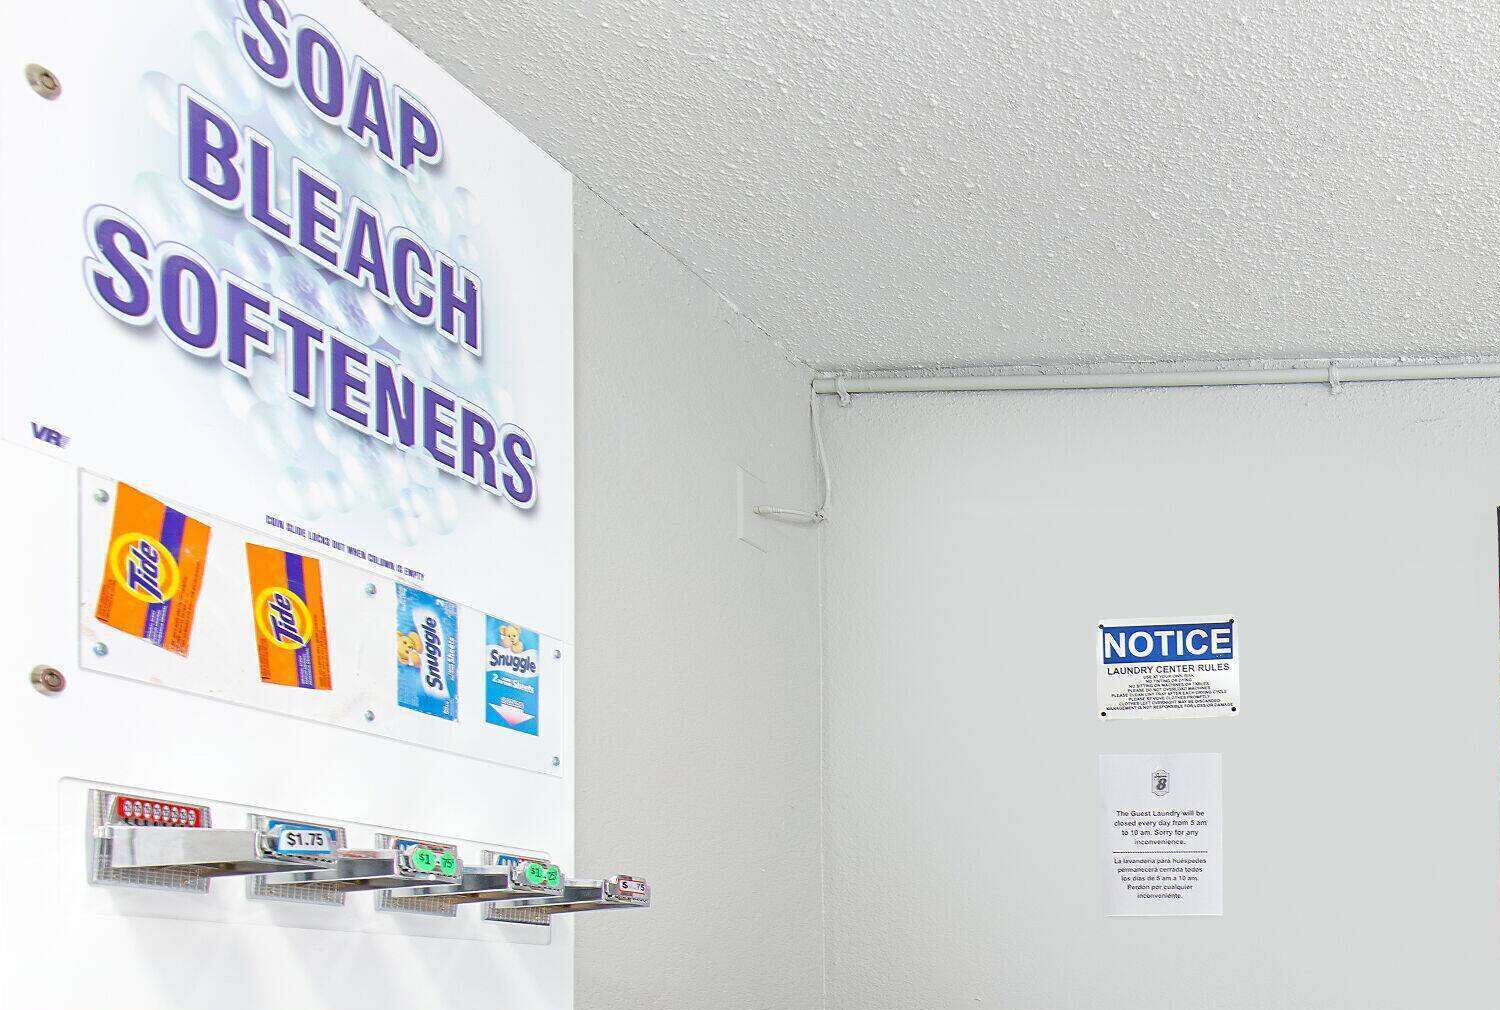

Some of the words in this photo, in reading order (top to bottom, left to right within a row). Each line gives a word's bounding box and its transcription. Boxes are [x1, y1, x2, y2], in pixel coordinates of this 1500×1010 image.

[242, 0, 440, 170] SOAP
[187, 95, 481, 351] BLEACH
[92, 217, 535, 506] SOFTENERS
[128, 540, 163, 603] Tide
[270, 592, 306, 646] Tide
[422, 616, 444, 691] Snuggle
[489, 649, 537, 674] Snuggle
[1104, 628, 1232, 659] NOTICE
[1107, 666, 1153, 676] LAUNDRY
[1156, 665, 1194, 674] CENTER
[1198, 662, 1230, 672] RULES
[1152, 810, 1180, 818] Laundry
[1154, 829, 1172, 837] Sorry
[286, 832, 324, 847] $1.75
